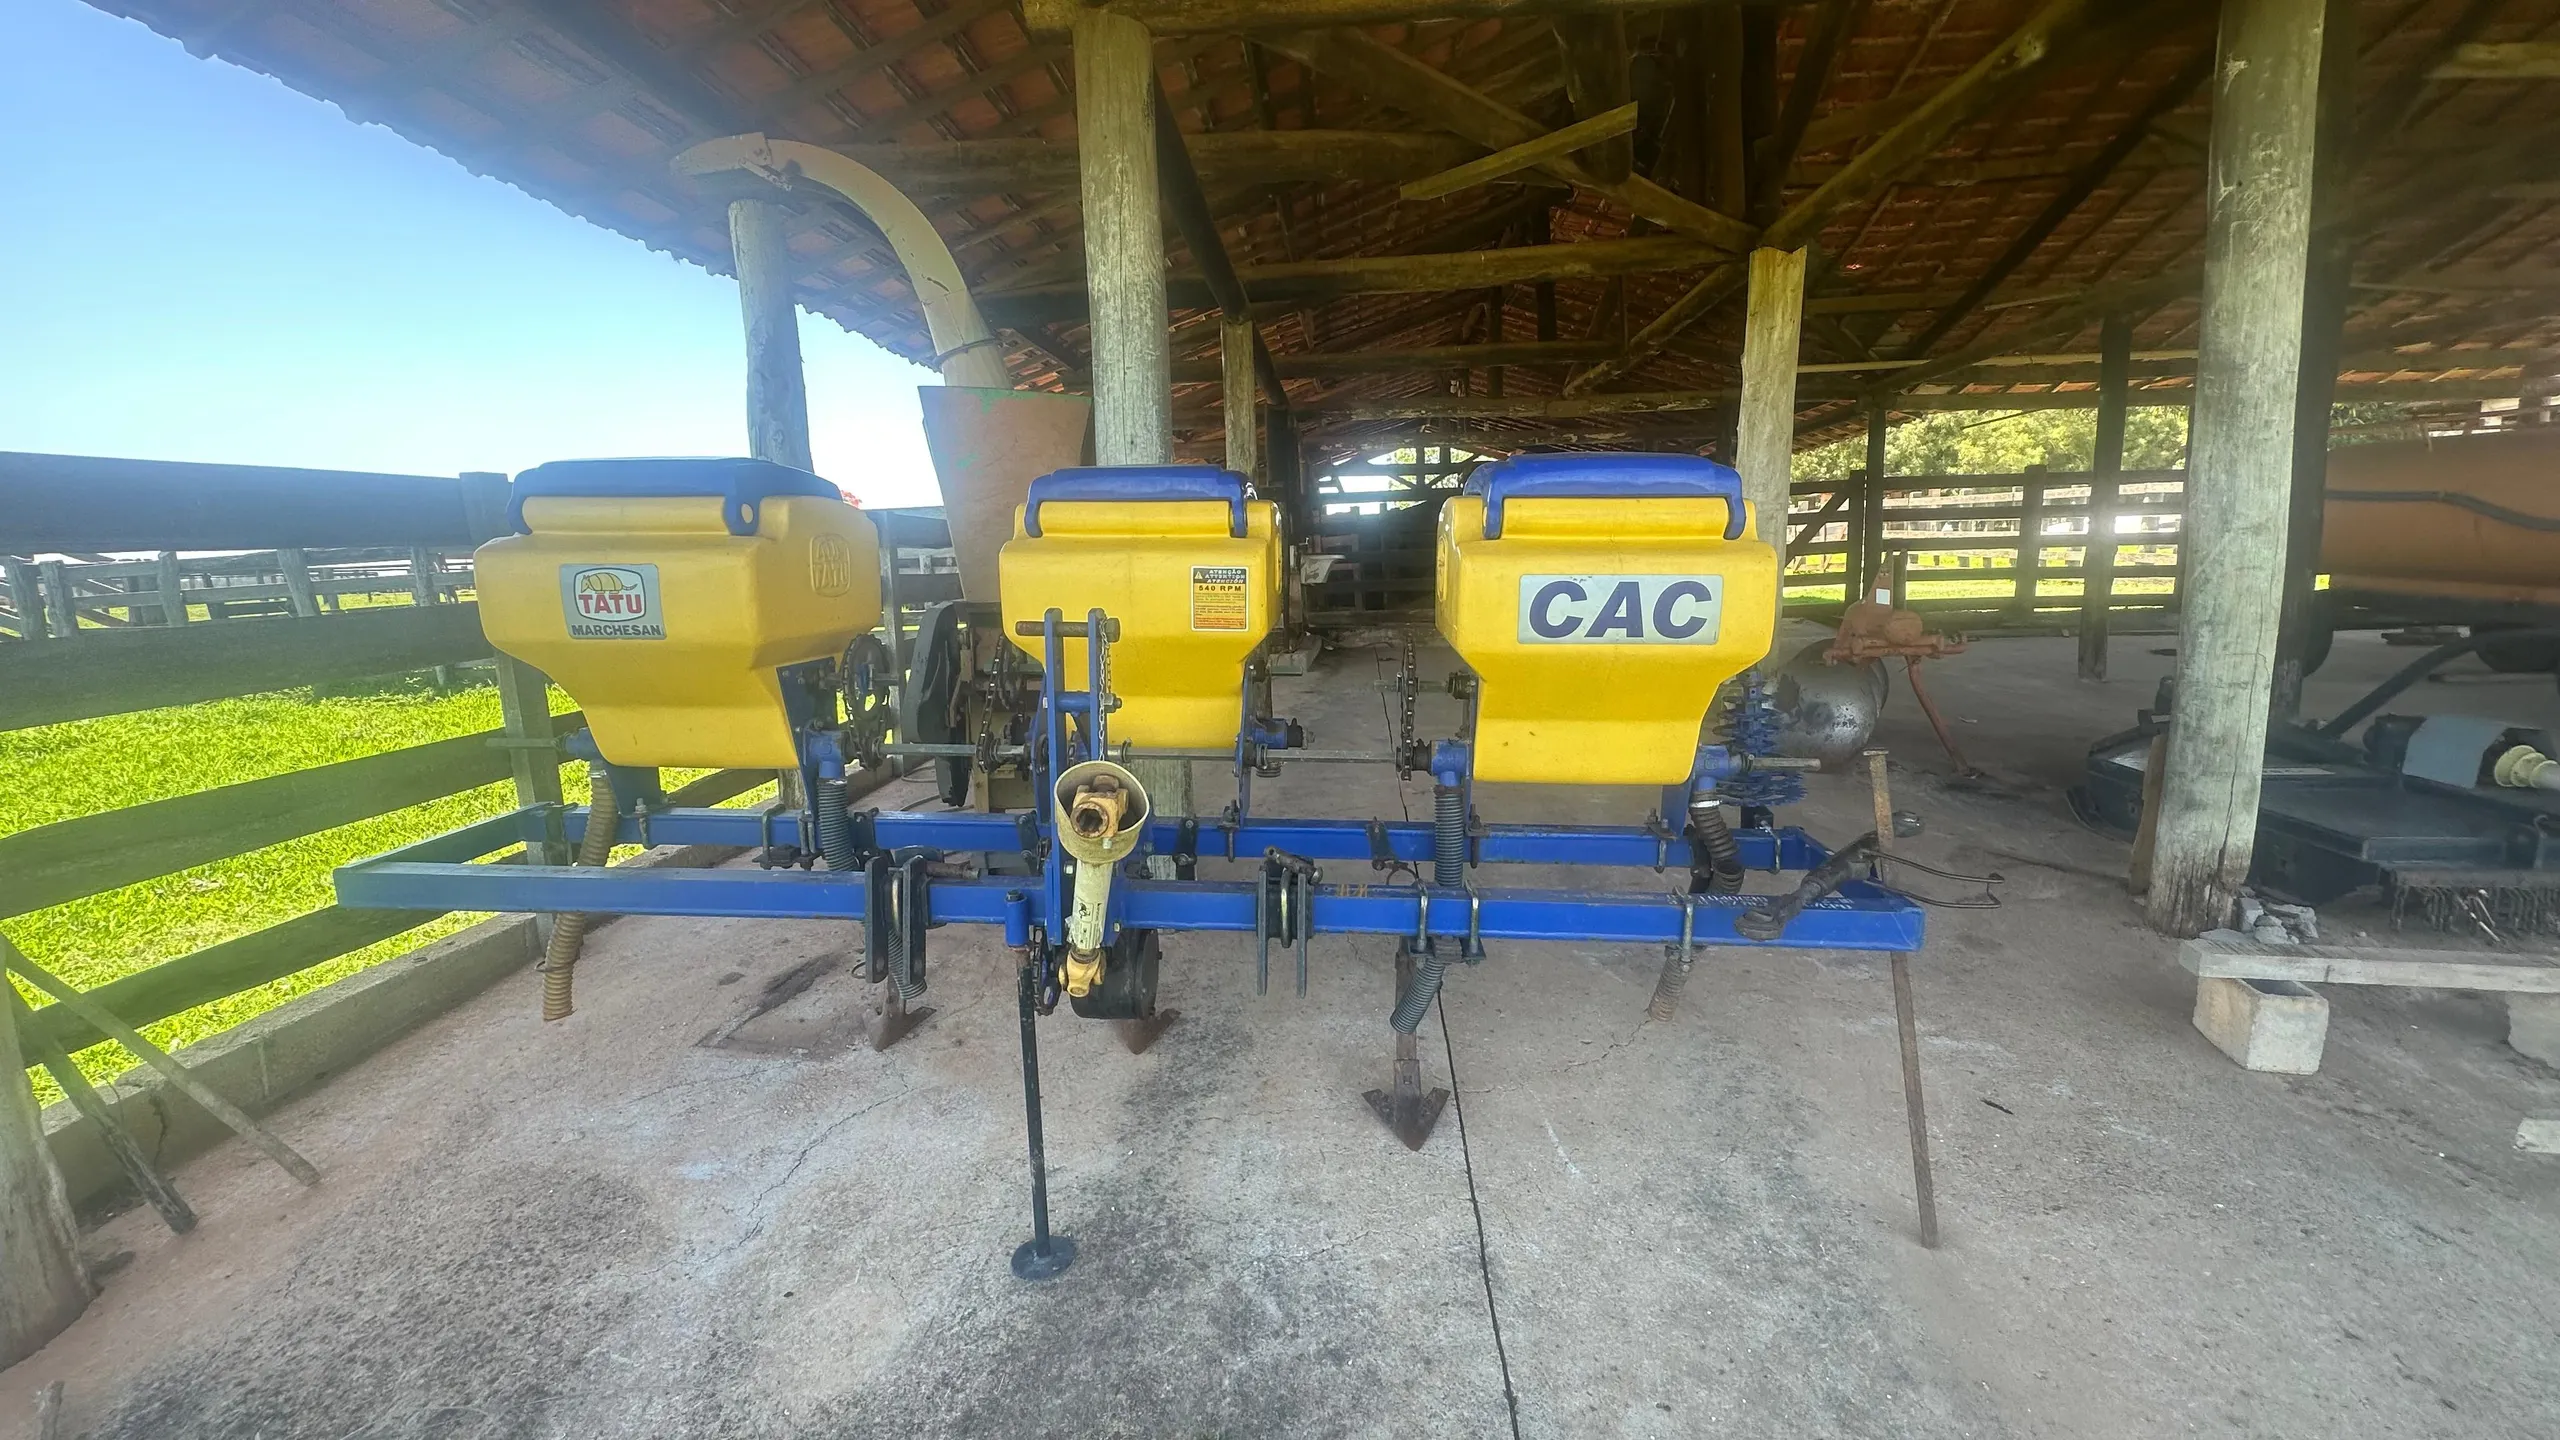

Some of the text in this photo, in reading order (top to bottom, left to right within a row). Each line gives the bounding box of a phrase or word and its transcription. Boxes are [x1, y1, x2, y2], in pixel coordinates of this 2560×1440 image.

[578, 594, 643, 614] TATU
[1528, 580, 1713, 640] CAC
[571, 624, 662, 636] MARCHESAN
